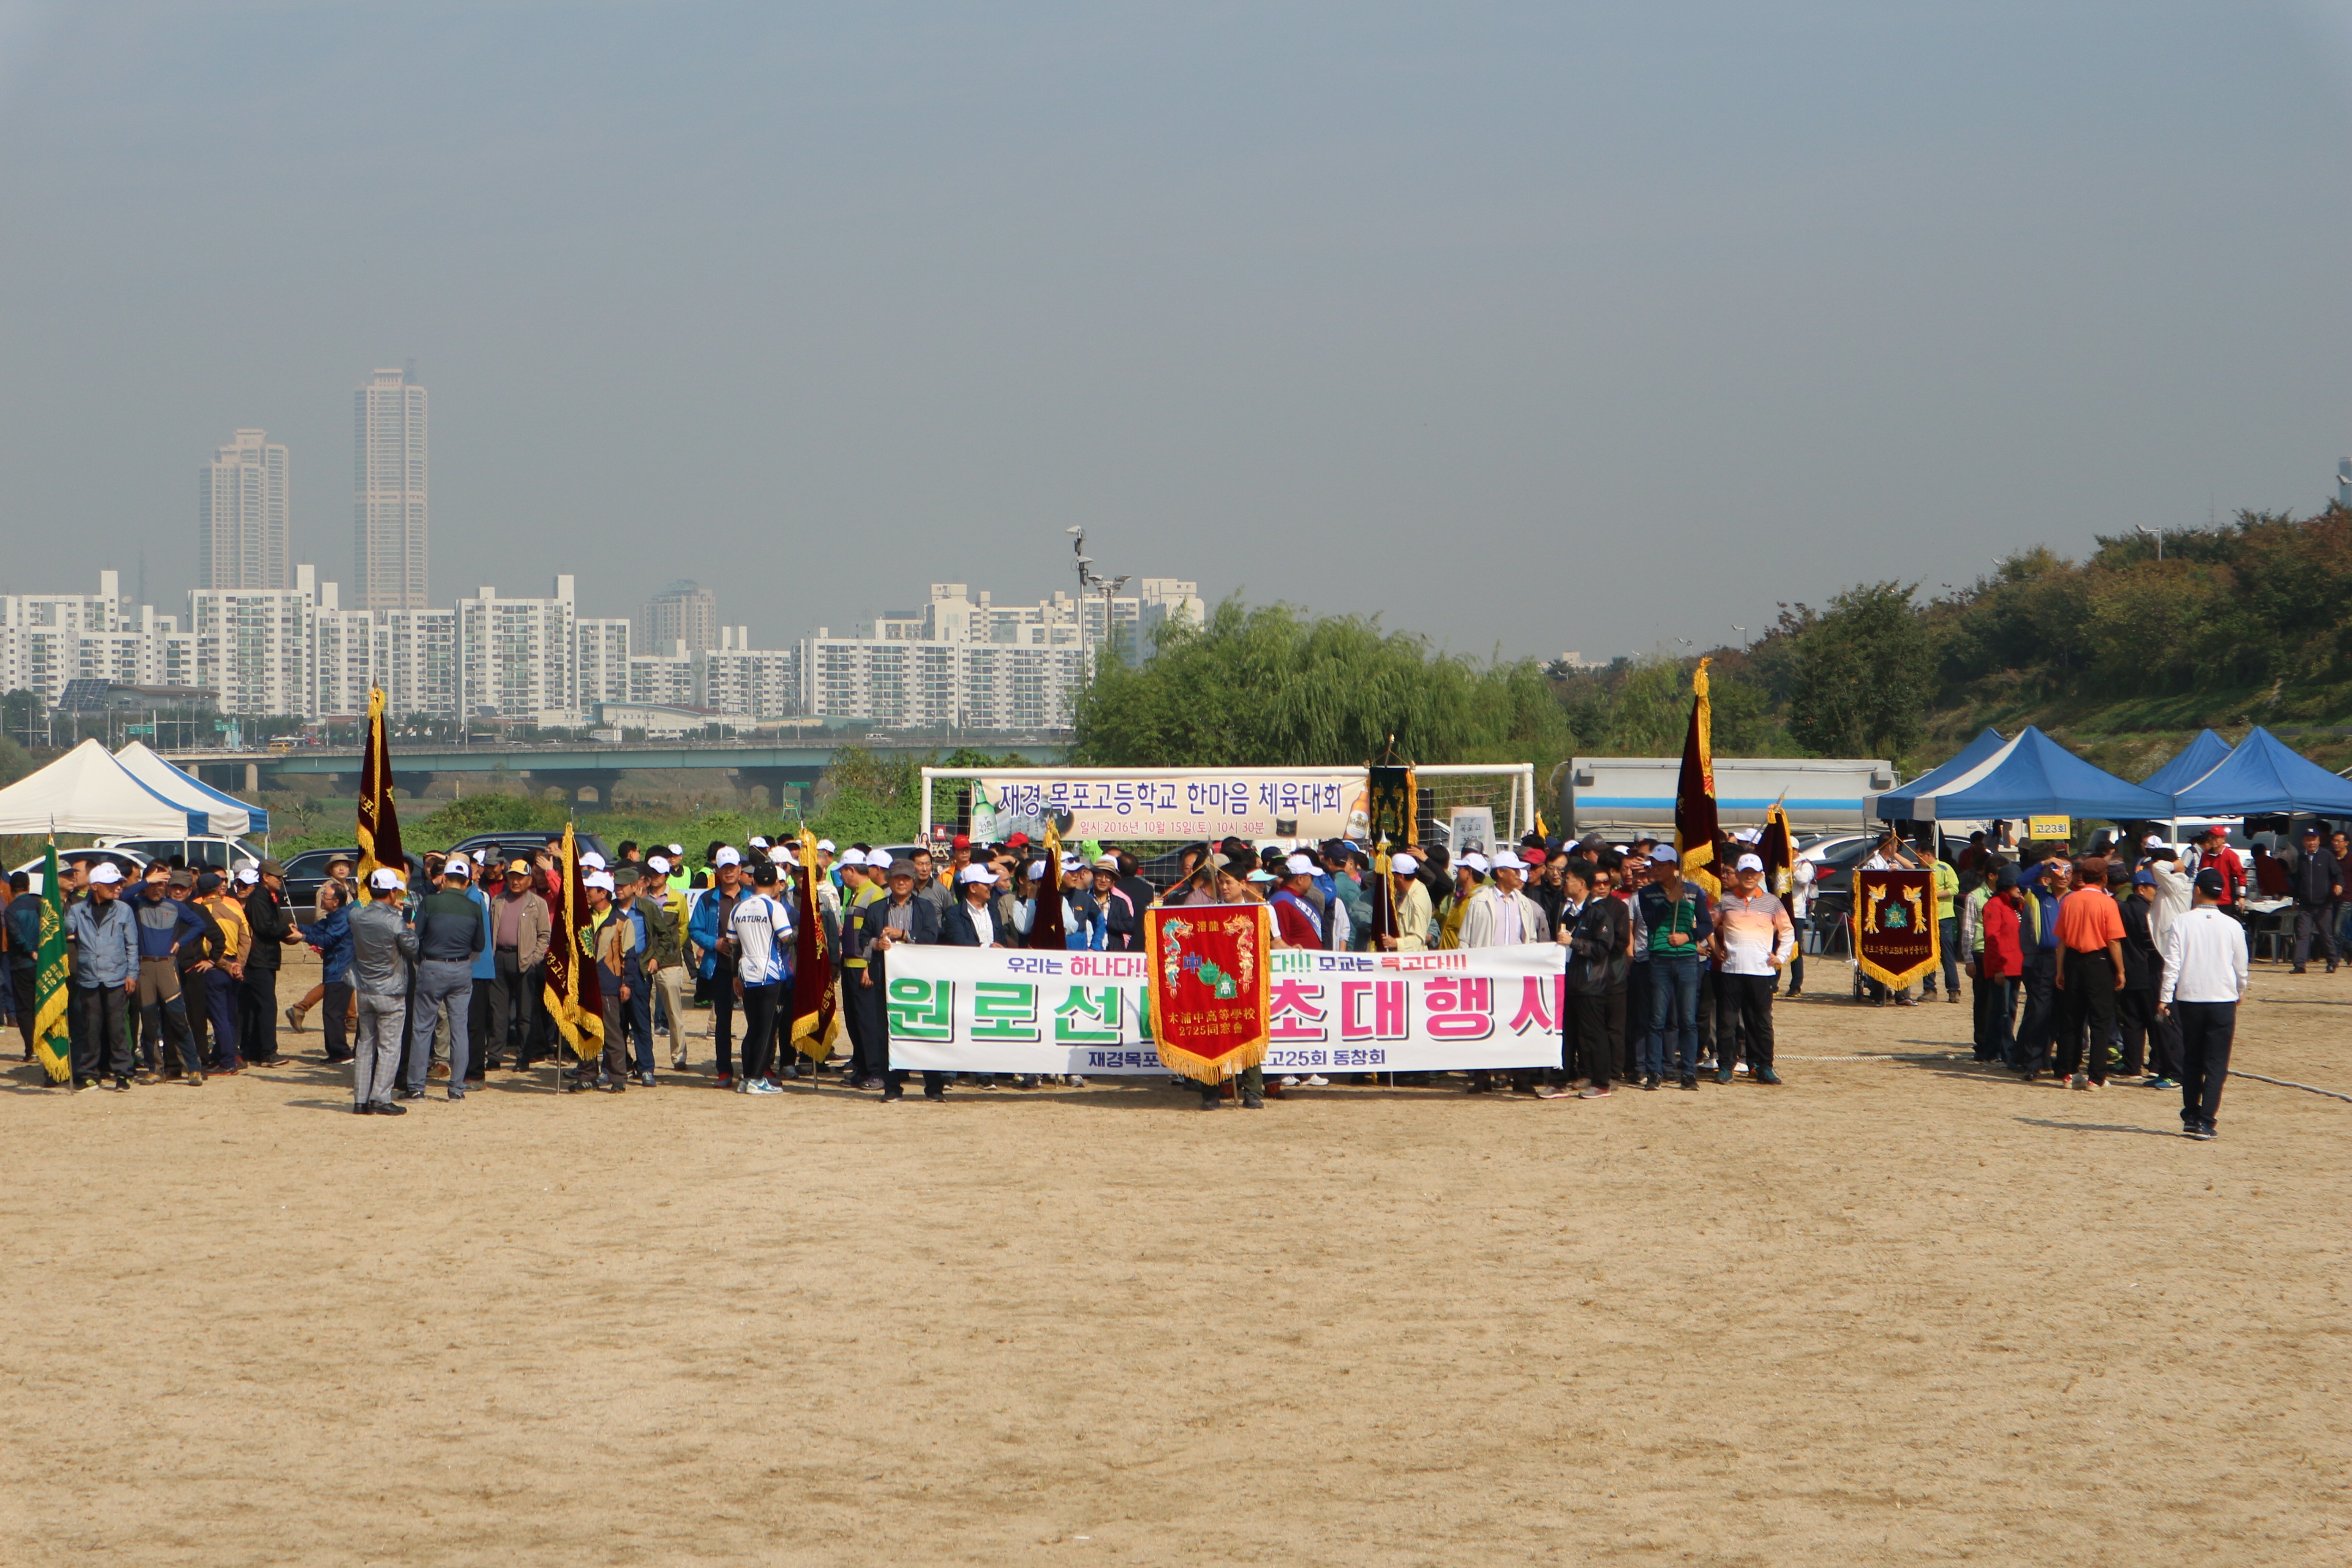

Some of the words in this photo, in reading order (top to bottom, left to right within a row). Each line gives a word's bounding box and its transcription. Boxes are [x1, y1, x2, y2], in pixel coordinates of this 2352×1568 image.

[999, 784, 1040, 817] 재경
[1049, 782, 1178, 816] 목포고등학교
[1187, 782, 1250, 815] 한마음
[1259, 782, 1342, 815] 체육대회
[1080, 821, 1139, 834] 일시:2016년
[1144, 821, 1166, 834] 10월
[1171, 820, 1212, 834] 15일(토)
[1217, 820, 1238, 834] 10시
[1242, 820, 1265, 834] 30분
[2035, 824, 2067, 834] 고23회
[735, 915, 768, 924] NATURA
[1007, 957, 1063, 975] 우리는
[1319, 956, 1375, 972] 모교는
[1381, 954, 1467, 971] 목고다!!!
[1183, 952, 1203, 974] 中
[1089, 1051, 1164, 1069] 재경목포
[1333, 1049, 1386, 1066] 동창회
